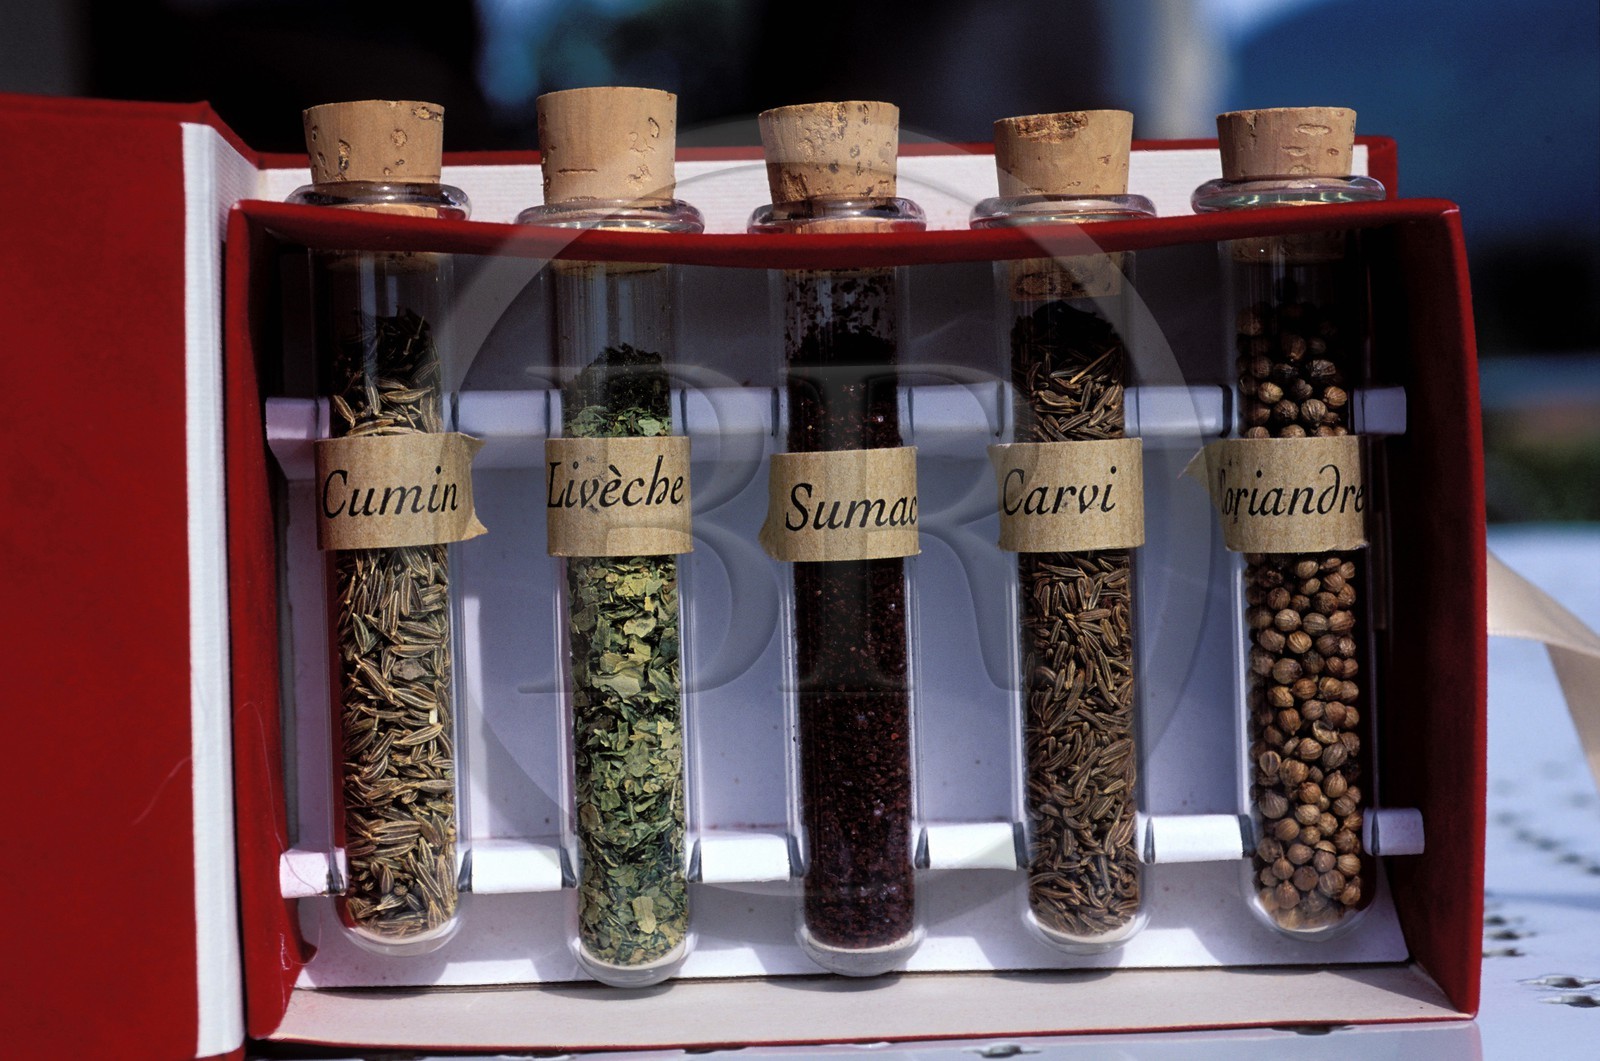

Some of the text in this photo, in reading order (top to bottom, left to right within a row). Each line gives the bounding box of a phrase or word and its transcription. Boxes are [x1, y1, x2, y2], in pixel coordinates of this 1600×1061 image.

[322, 465, 459, 518] Cumin
[546, 455, 685, 508] Livèche
[785, 482, 918, 531] Sumac
[1003, 466, 1117, 516] Carvi
